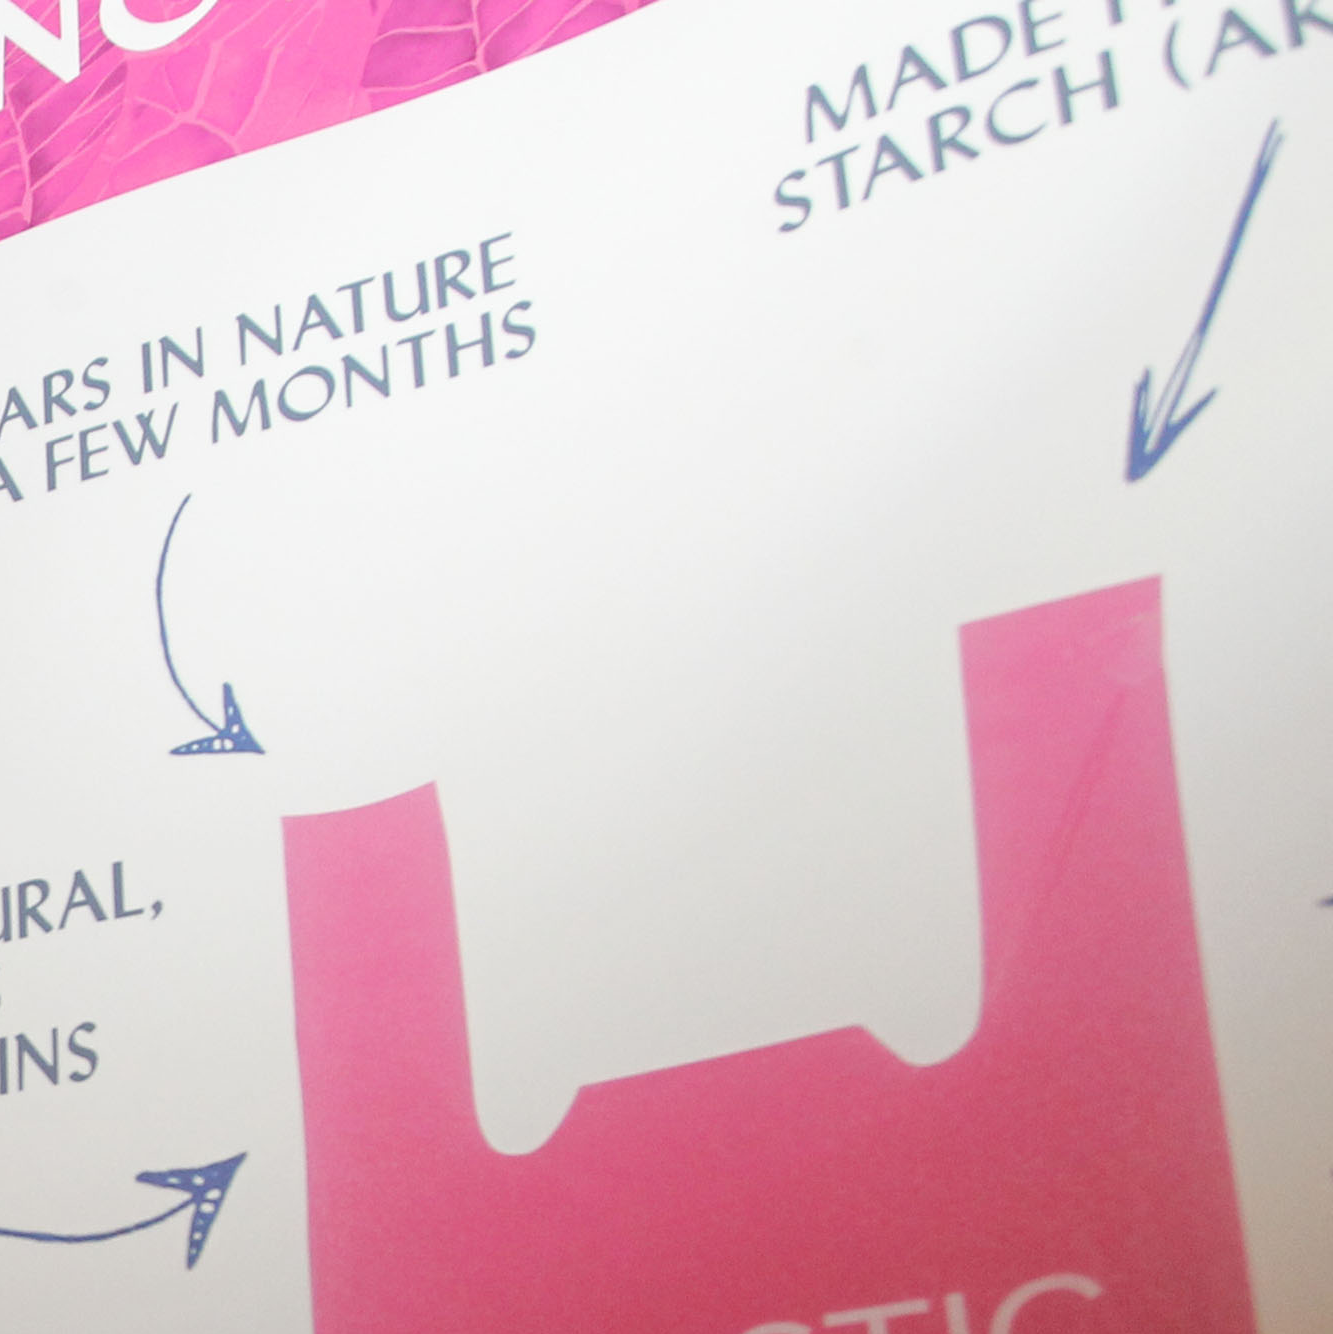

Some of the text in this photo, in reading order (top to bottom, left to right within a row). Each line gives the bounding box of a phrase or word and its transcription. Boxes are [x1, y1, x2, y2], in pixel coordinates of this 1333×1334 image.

[773, 48, 1122, 234] STARCH
[805, 0, 1067, 144] MADE
[45, 403, 180, 493] FEW
[211, 300, 537, 444] MONTHS
[141, 326, 206, 394] IN
[237, 232, 519, 367] NATURE
